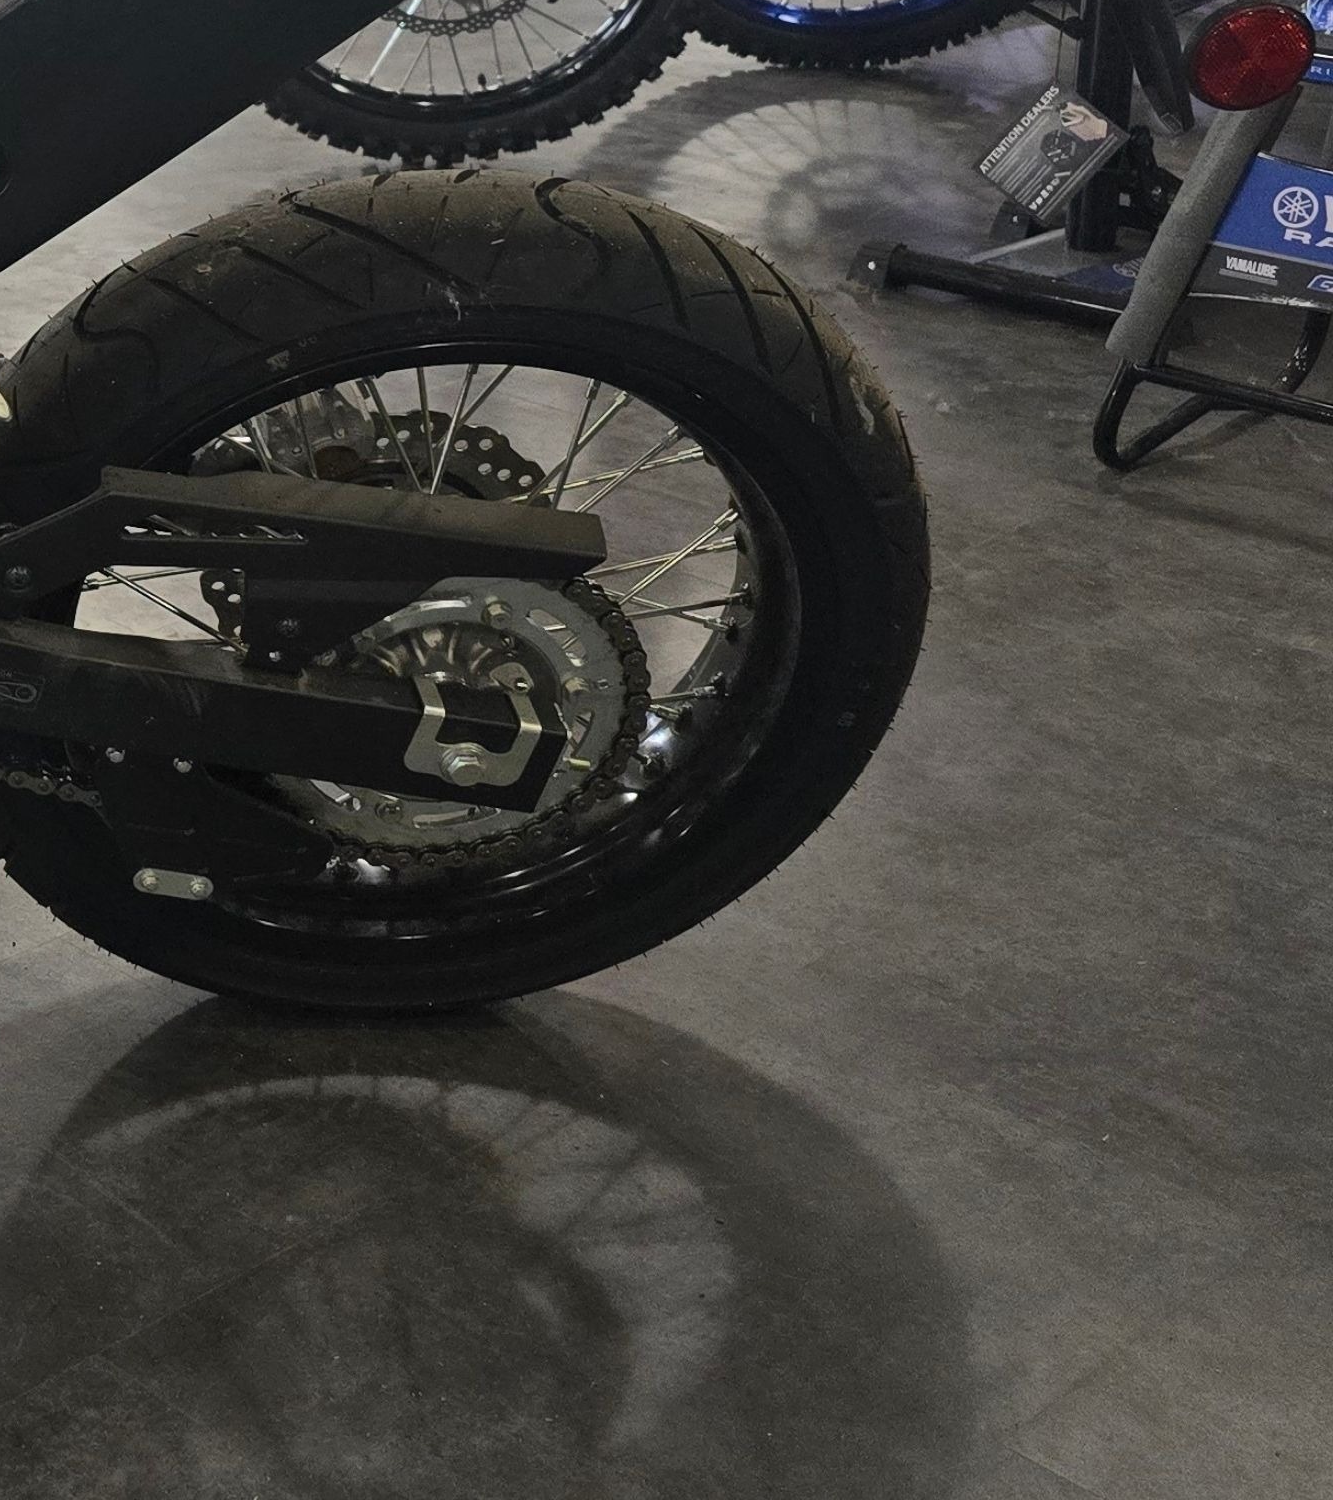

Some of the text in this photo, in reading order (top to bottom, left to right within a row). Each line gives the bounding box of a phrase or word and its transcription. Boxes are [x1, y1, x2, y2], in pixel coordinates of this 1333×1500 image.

[979, 124, 1024, 174] ATTENTION
[1020, 85, 1060, 128] DEALERS
[1226, 255, 1280, 279] YAMALUBE
